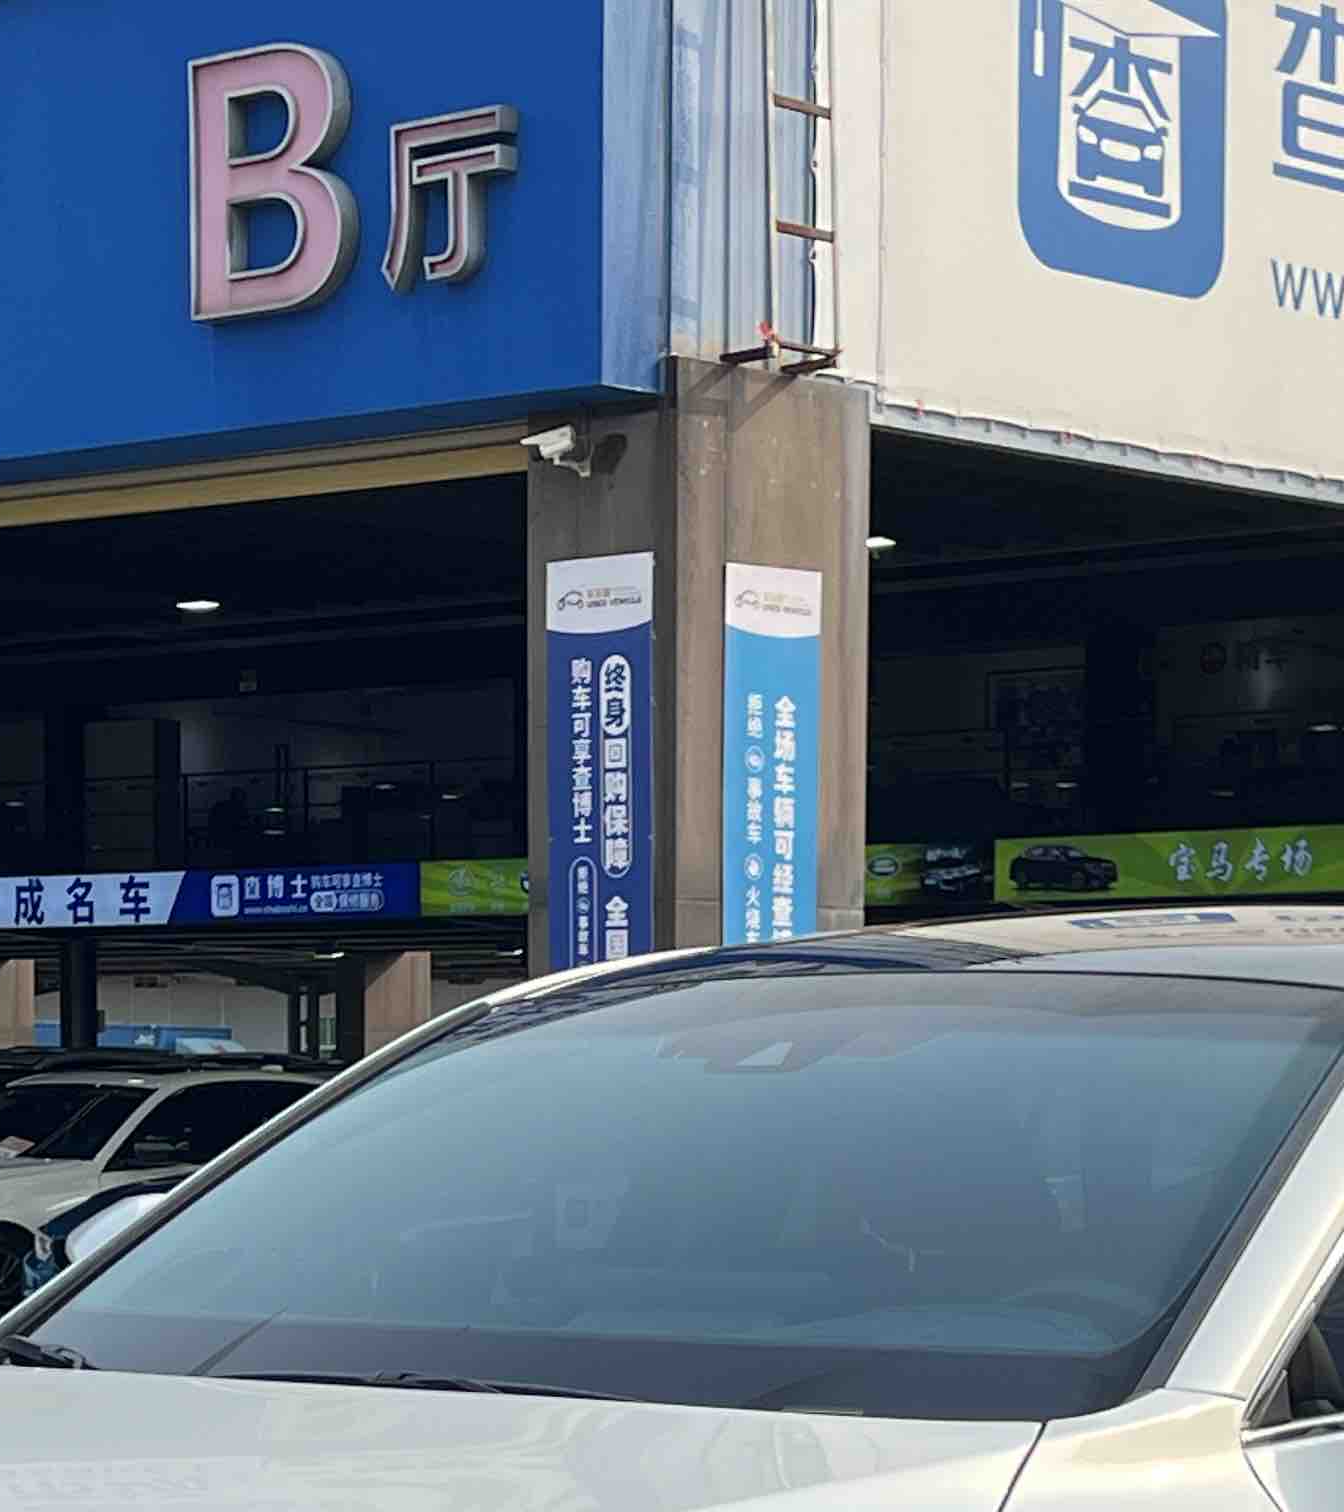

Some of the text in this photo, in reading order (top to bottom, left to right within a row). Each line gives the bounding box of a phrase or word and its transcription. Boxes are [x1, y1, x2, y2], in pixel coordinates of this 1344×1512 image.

[569, 657, 593, 845] 购车可享查博士
[1168, 838, 1313, 881] 宝马专场
